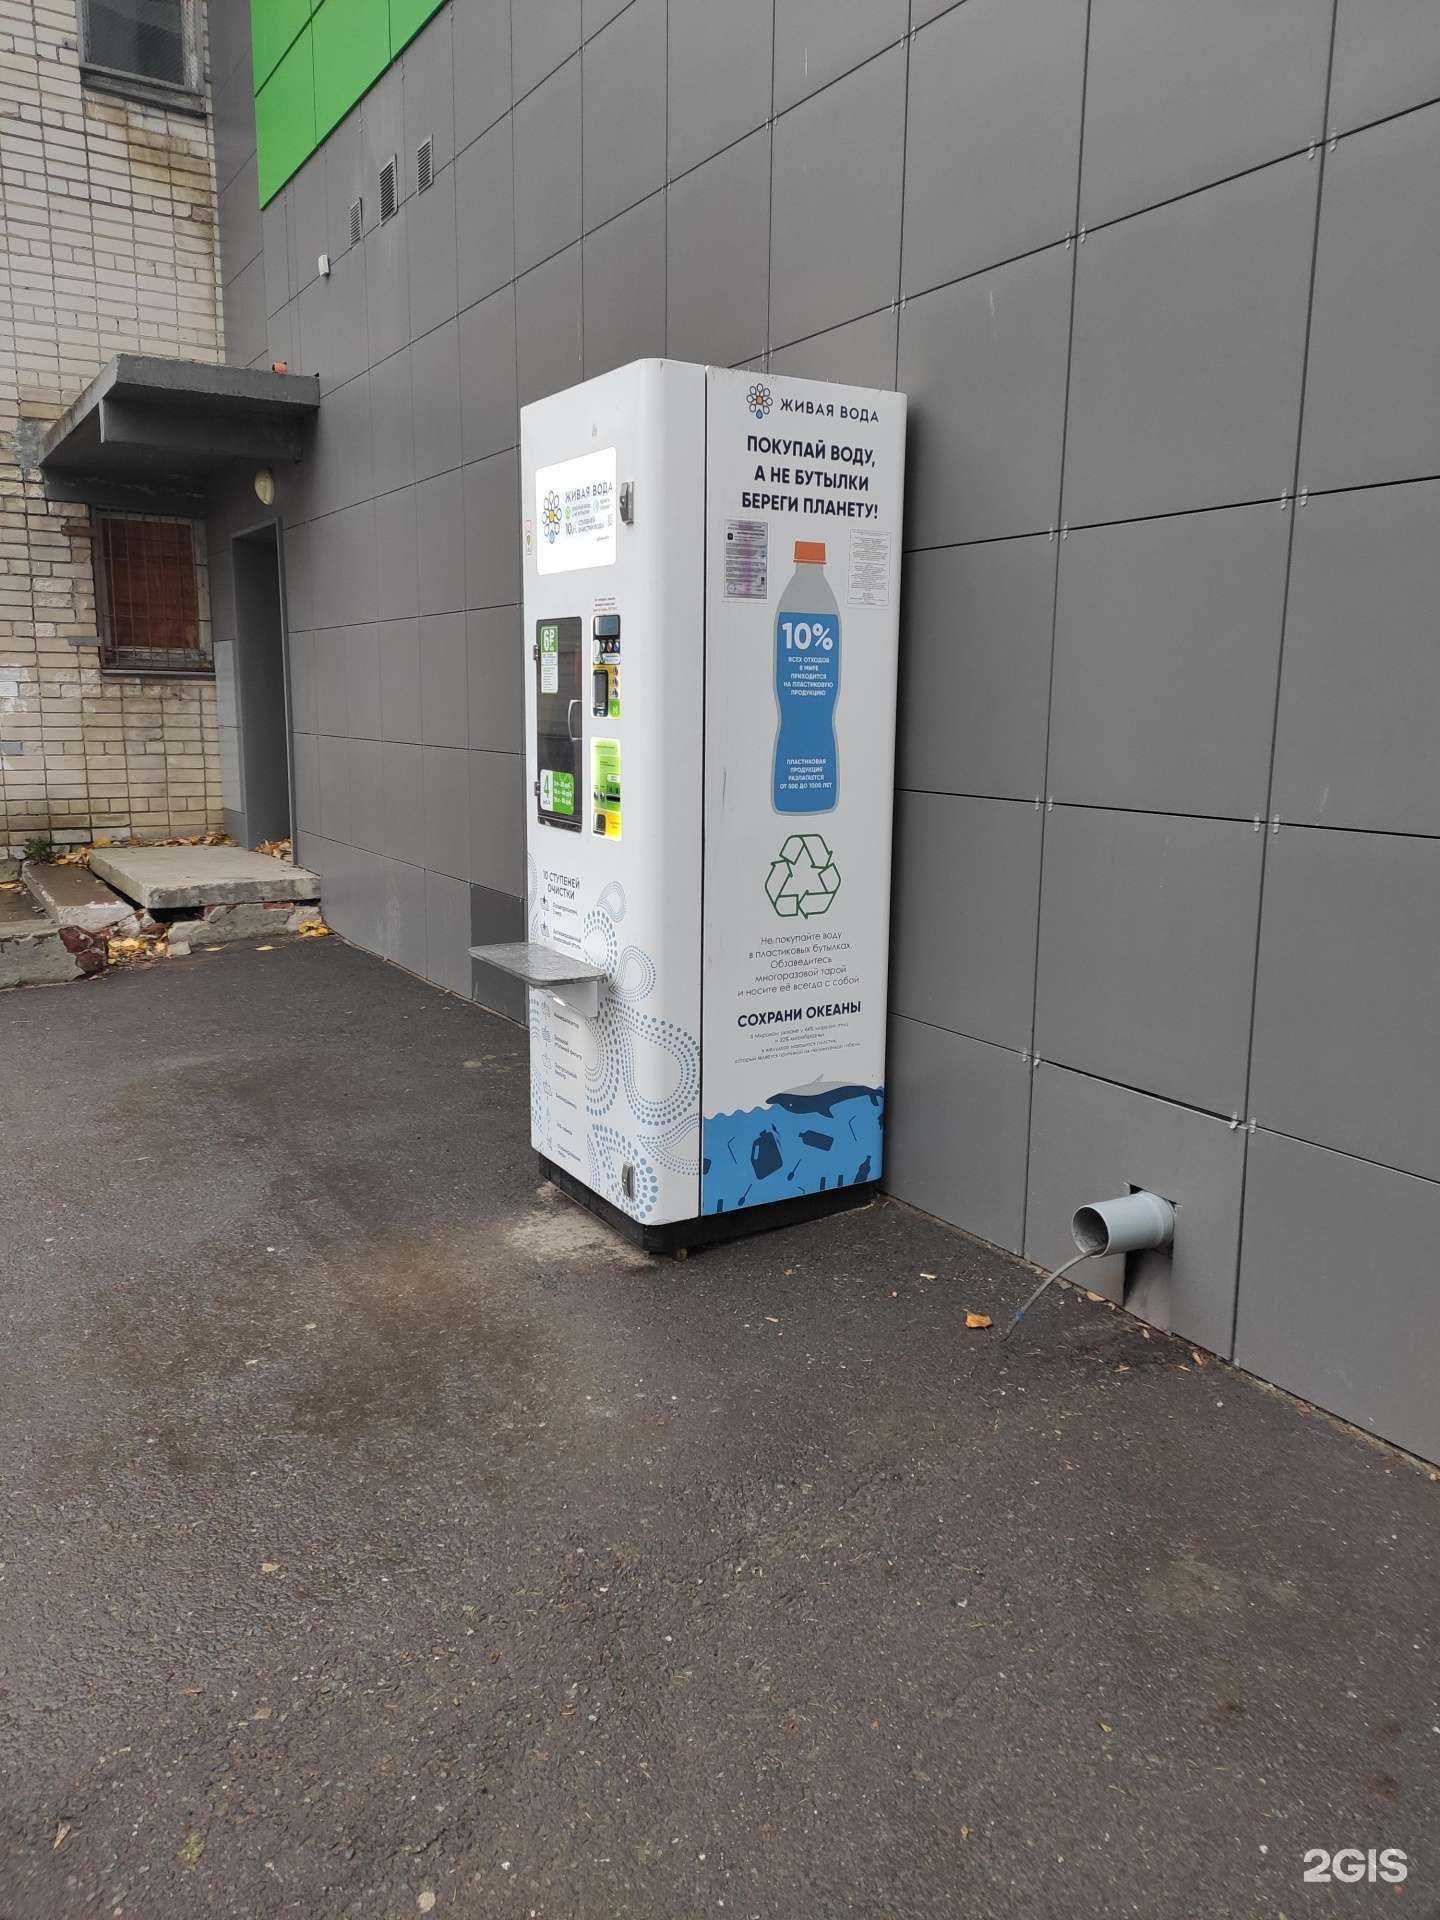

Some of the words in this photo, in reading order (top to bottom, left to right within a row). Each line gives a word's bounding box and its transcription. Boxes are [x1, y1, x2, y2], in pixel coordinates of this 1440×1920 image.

[780, 398, 835, 417] ЖИВАЯ
[840, 407, 879, 423] ВОДА
[747, 434, 826, 460] ПОКУПАЙ
[831, 445, 876, 468] ВОДУ,
[754, 465, 766, 482] А
[770, 467, 790, 484] НЕ
[795, 469, 869, 491] БУТЫЛКИ
[565, 486, 591, 503] ЖИВАЯ
[592, 481, 613, 497] ВОДА
[742, 492, 799, 513] БЕРЕГИ
[803, 498, 879, 519] ПЛАНЕТУ!
[781, 622, 833, 650] 10%
[803, 656, 830, 664] ОТХОДОВ
[790, 689, 827, 697] ПРОДУКЦИЮ
[547, 883, 575, 900] ОЧИСТКИ
[761, 936, 773, 945] Не
[775, 931, 821, 944] покупайте
[822, 931, 843, 940] воду
[755, 947, 810, 959] пластиковых
[770, 956, 833, 969] Обзаведитесь
[754, 968, 819, 983] многоразовой
[820, 965, 847, 976] тарой
[745, 986, 777, 997] носите
[793, 980, 823, 991] всегда
[832, 975, 860, 986] собой
[737, 1007, 802, 1028] СОХРАНИ
[806, 1000, 861, 1019] ОКЕАНЫ
